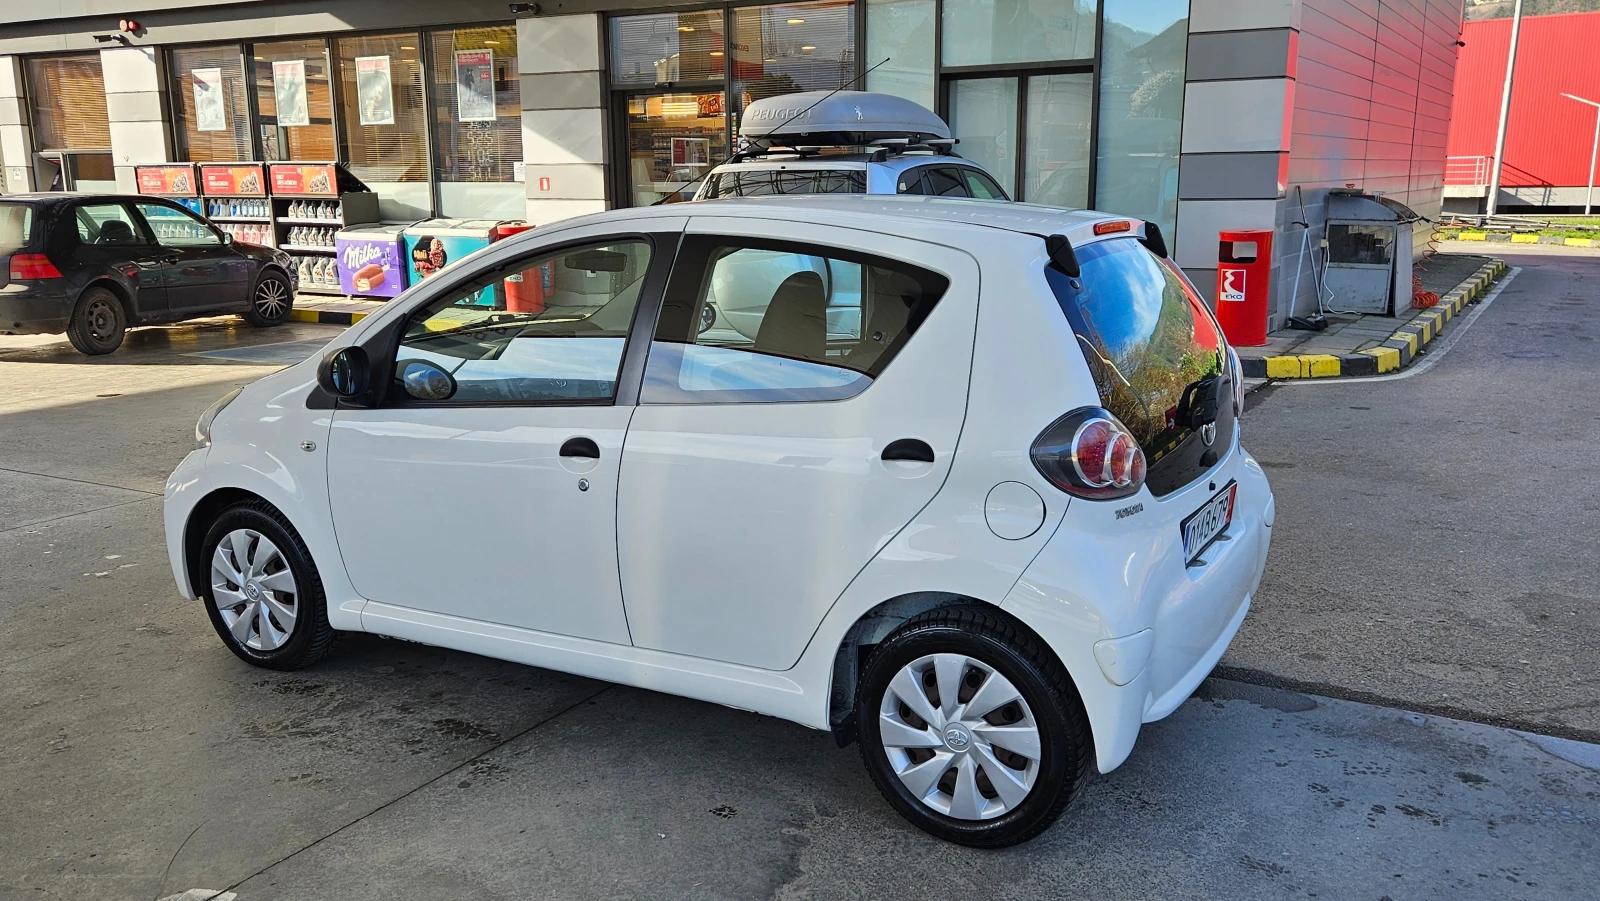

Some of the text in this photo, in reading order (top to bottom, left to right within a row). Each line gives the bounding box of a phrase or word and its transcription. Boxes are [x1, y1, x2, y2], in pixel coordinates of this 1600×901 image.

[751, 107, 816, 121] PEUGEOT
[343, 242, 382, 269] Milka
[1115, 502, 1143, 520] TOYOTA
